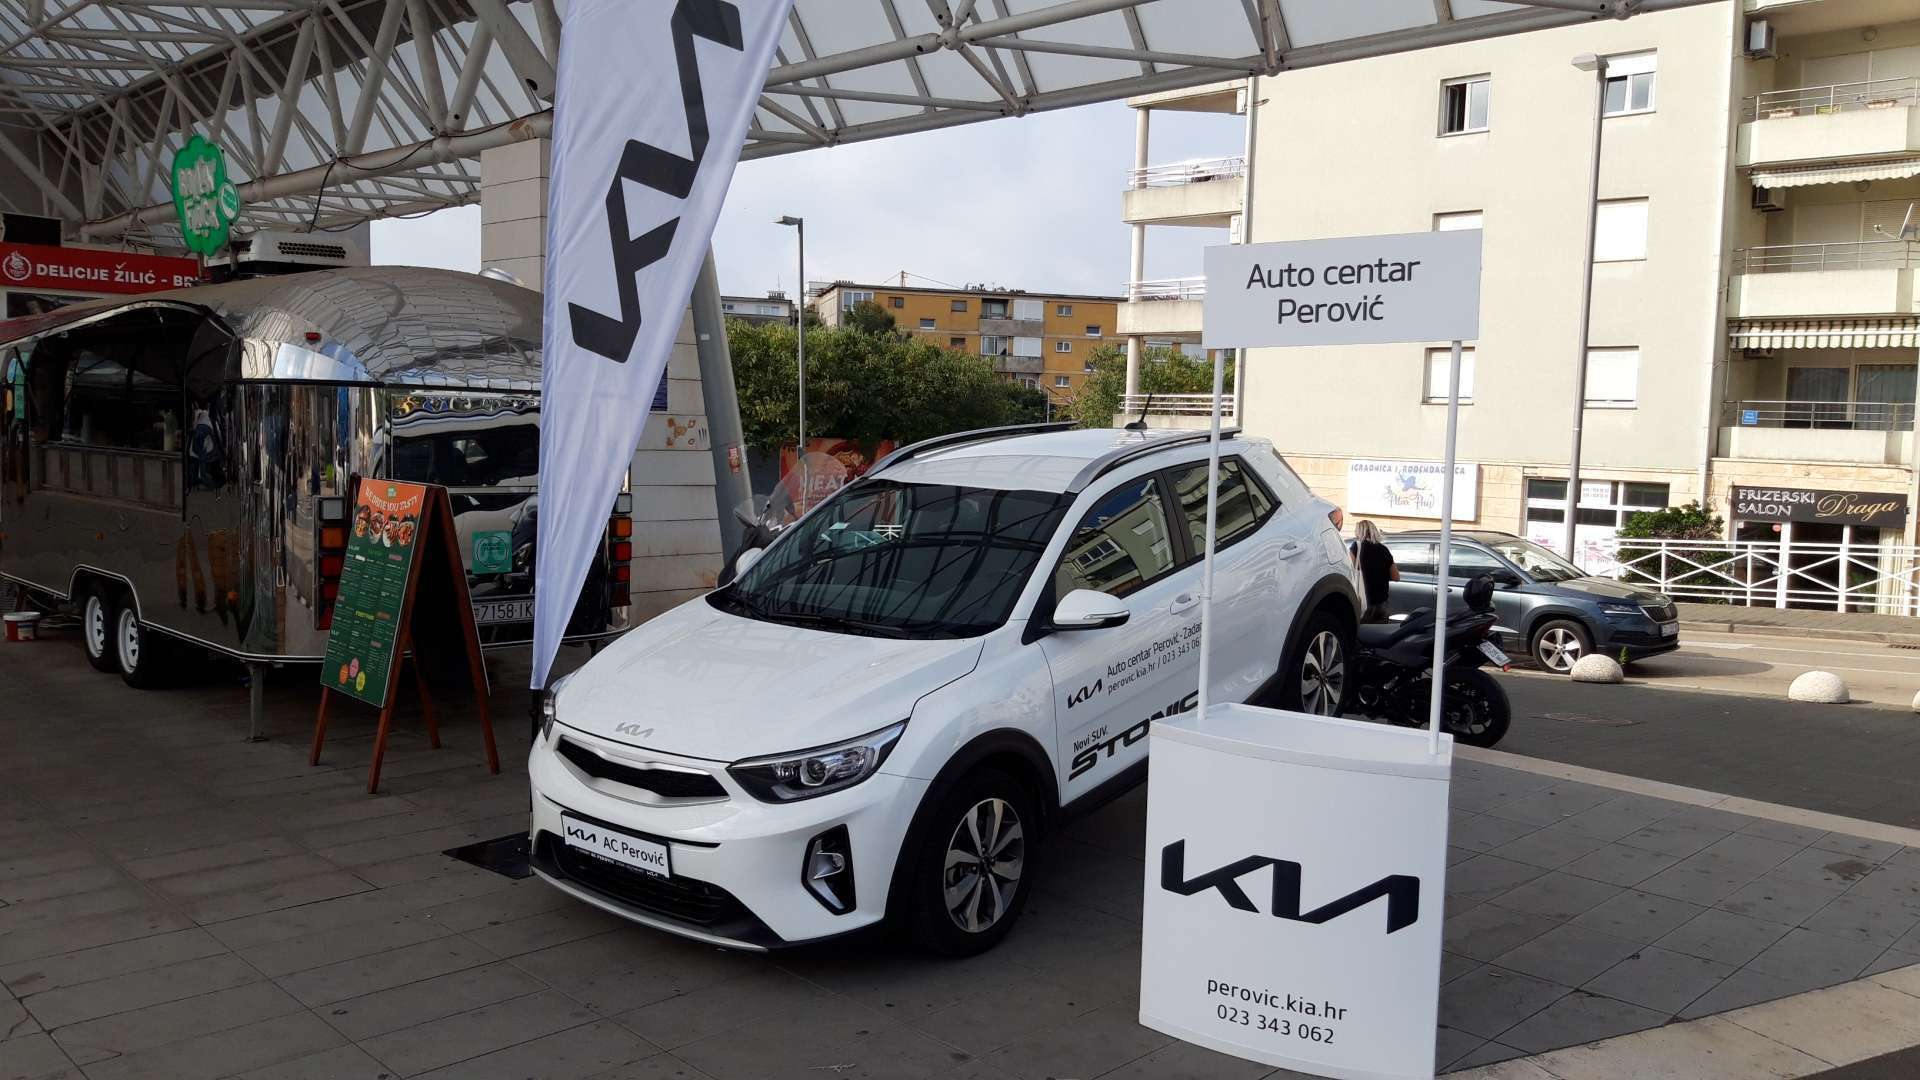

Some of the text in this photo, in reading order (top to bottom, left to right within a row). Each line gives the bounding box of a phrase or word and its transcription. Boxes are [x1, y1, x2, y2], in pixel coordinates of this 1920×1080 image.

[36, 263, 109, 281] DELICIJE
[114, 261, 155, 284] ŽILIĆ
[173, 275, 199, 288] BR
[1246, 257, 1420, 289] Auto centar
[1277, 294, 1384, 324] Perović
[1351, 463, 1392, 473] IGRAONICA
[1737, 503, 1792, 517] SALON
[1738, 489, 1815, 504] FRIZERSKI
[1815, 493, 1899, 522] Draga
[1107, 661, 1126, 678] Auto
[1128, 648, 1152, 667] centar
[1153, 632, 1179, 654] Perović
[1108, 661, 1155, 696] perovic.kia.hr
[1163, 650, 1175, 664] 023
[1178, 643, 1189, 657] 343
[1067, 678, 1102, 709] KIA
[615, 722, 654, 738] KIA
[1068, 689, 1199, 782] STONIC
[1074, 735, 1090, 752] Novi
[567, 826, 597, 843] KIA
[603, 836, 619, 852] AC
[622, 841, 664, 866] Perović
[1161, 838, 1420, 935] KIA
[1207, 979, 1348, 1021] perovic.kia.hr
[1217, 1004, 1334, 1044] 023 343 062
